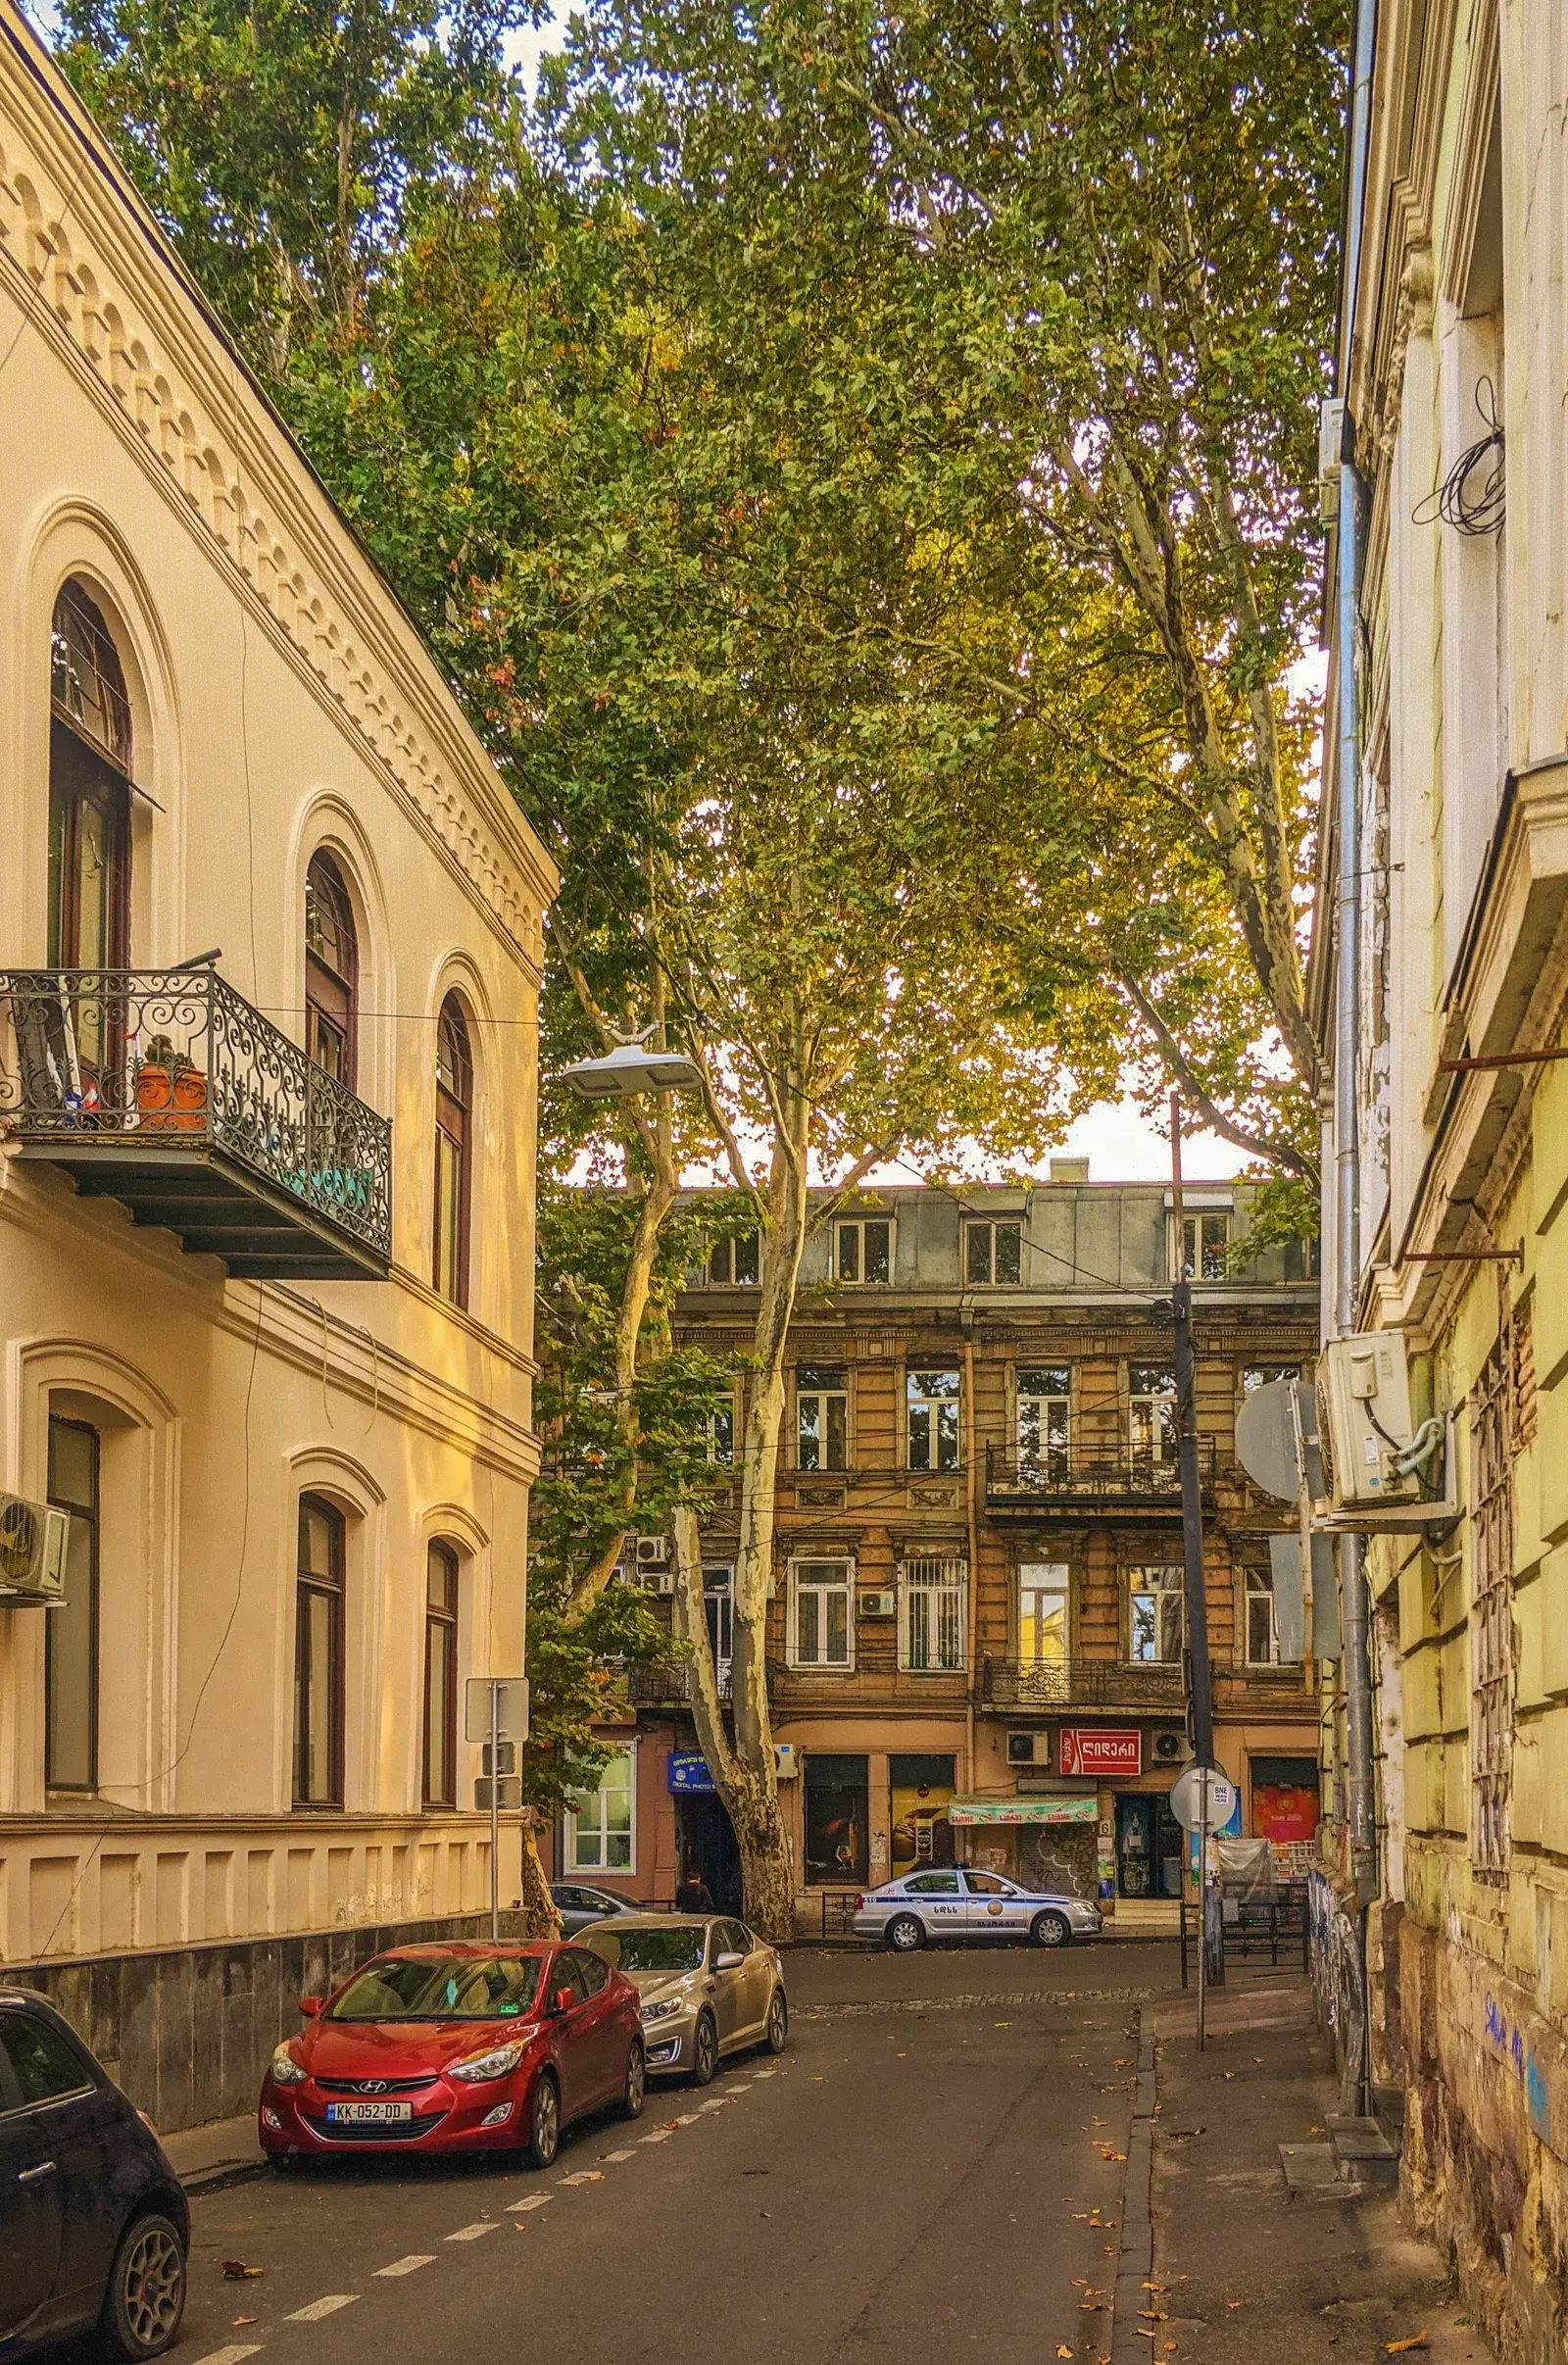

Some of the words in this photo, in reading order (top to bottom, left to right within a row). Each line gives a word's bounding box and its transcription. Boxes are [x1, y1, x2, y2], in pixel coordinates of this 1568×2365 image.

[1082, 1742, 1135, 1756] ლიდერი
[1102, 1823, 1109, 1834] 6
[337, 2104, 401, 2118] KK-052-DD
